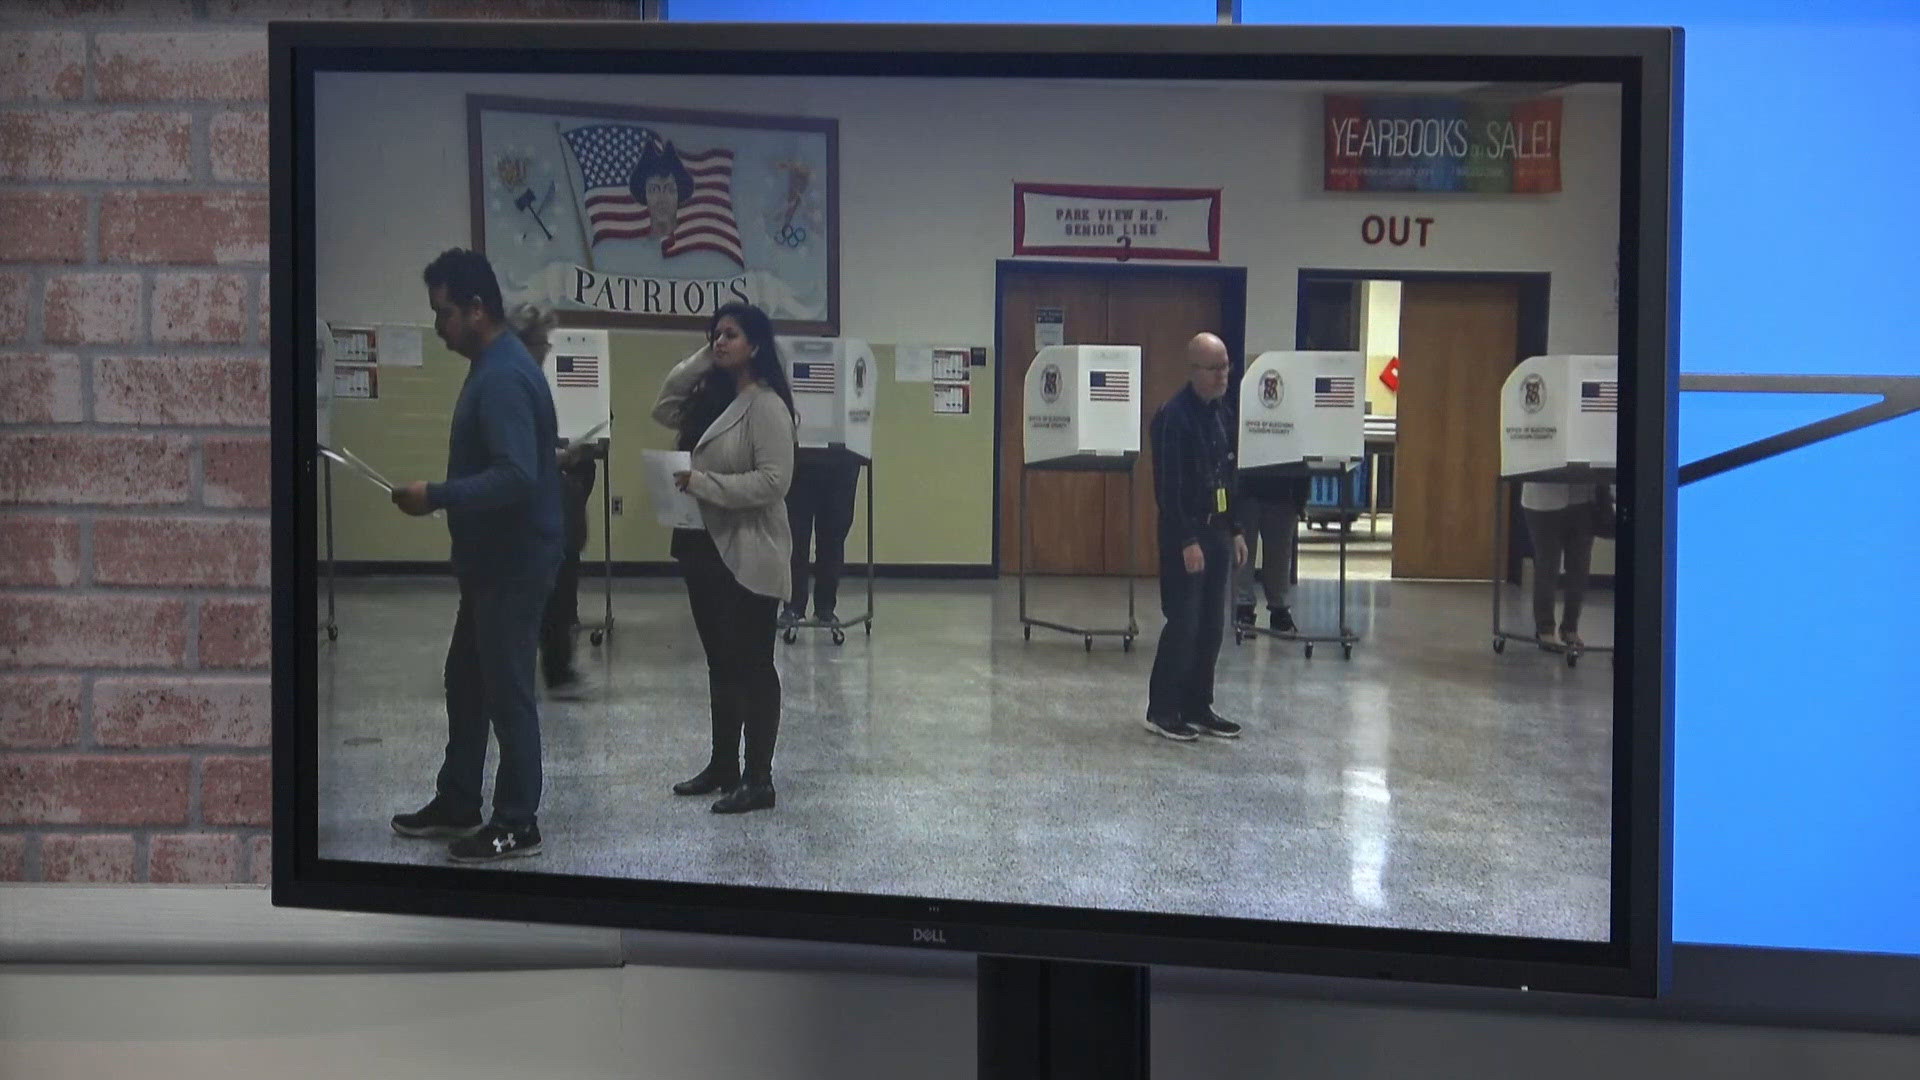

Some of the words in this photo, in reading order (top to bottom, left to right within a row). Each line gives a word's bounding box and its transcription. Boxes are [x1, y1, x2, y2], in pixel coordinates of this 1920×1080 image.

[1332, 118, 1468, 157] YEARBOOKS
[1487, 120, 1551, 160] SALE!
[1056, 209, 1089, 221] PARK
[1098, 209, 1134, 221] VIEW
[1064, 223, 1114, 236] SENIOR
[1123, 223, 1157, 236] LINE
[1362, 215, 1434, 247] OUT
[575, 267, 749, 314] PATRIOTS
[913, 928, 946, 944] DELL
